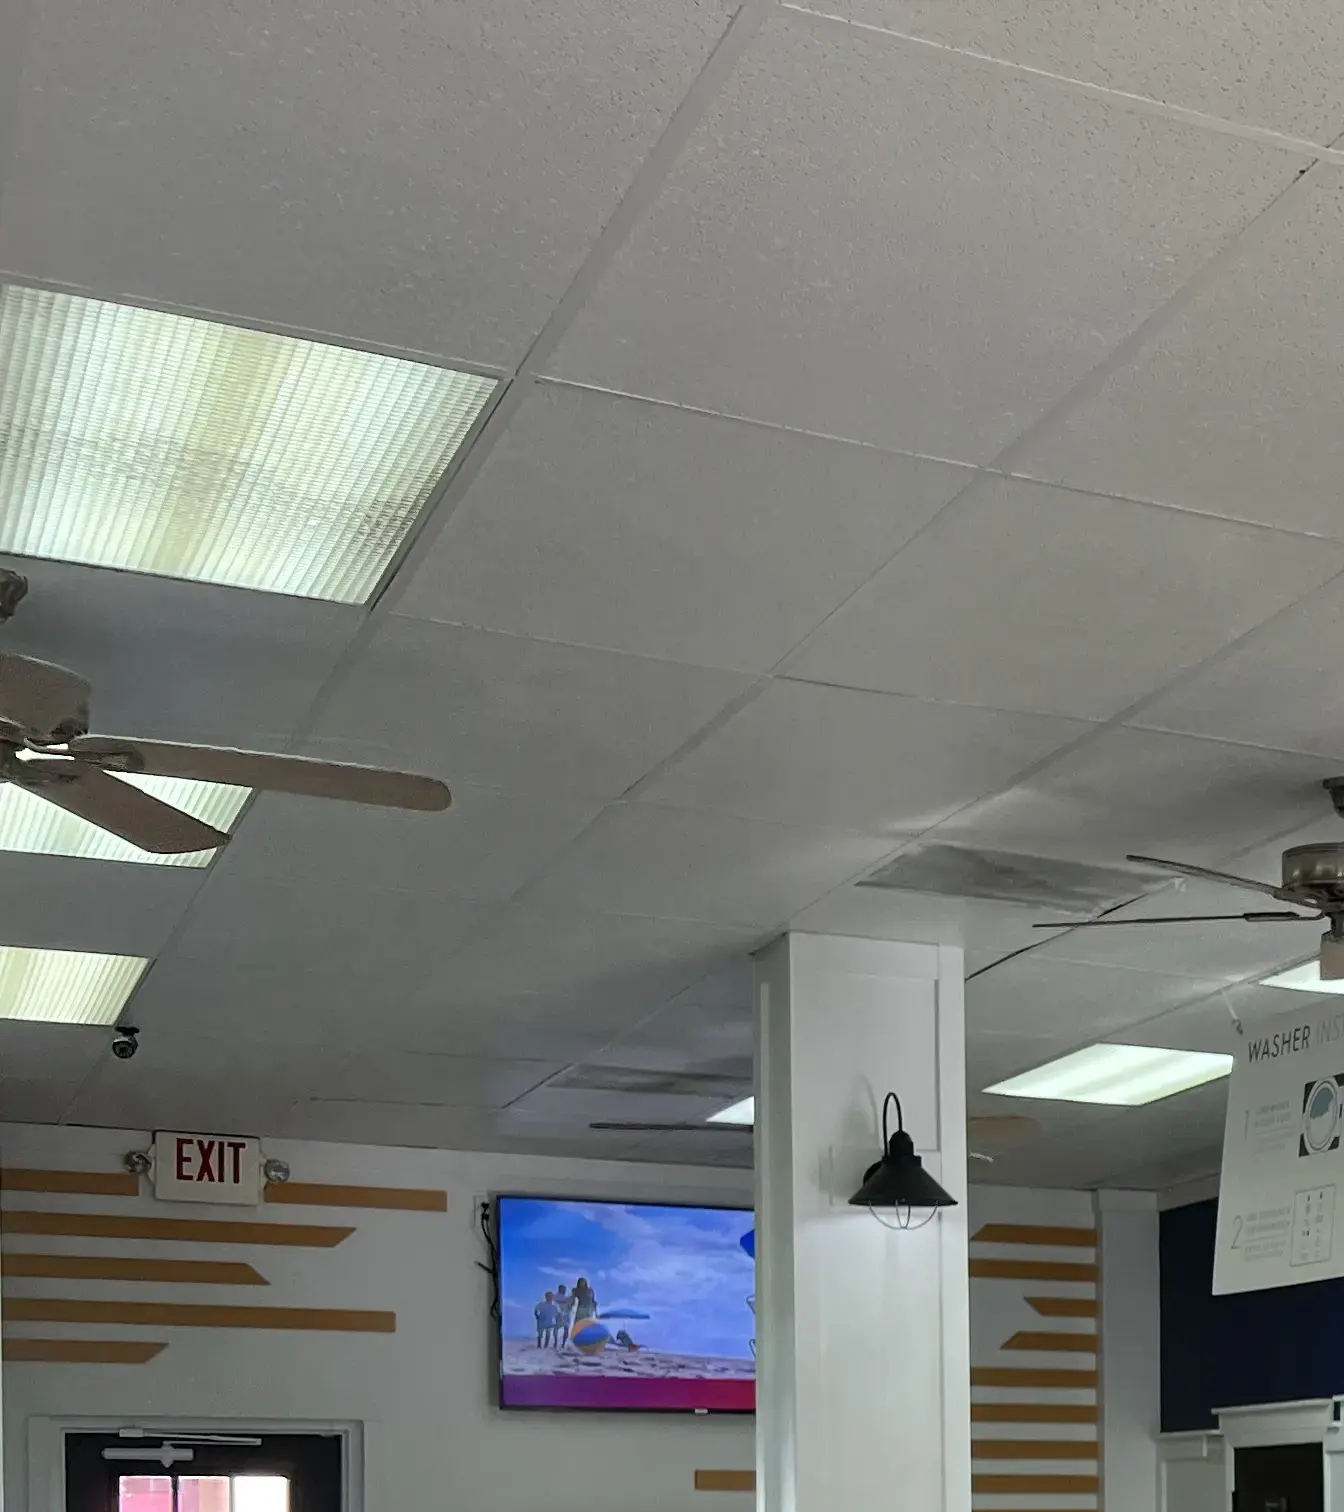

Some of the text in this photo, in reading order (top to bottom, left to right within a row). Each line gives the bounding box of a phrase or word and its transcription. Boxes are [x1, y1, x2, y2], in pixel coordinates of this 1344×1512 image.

[1247, 1025, 1311, 1064] WASHER
[176, 1138, 246, 1184] EXIT
[1231, 1215, 1243, 1250] 2
